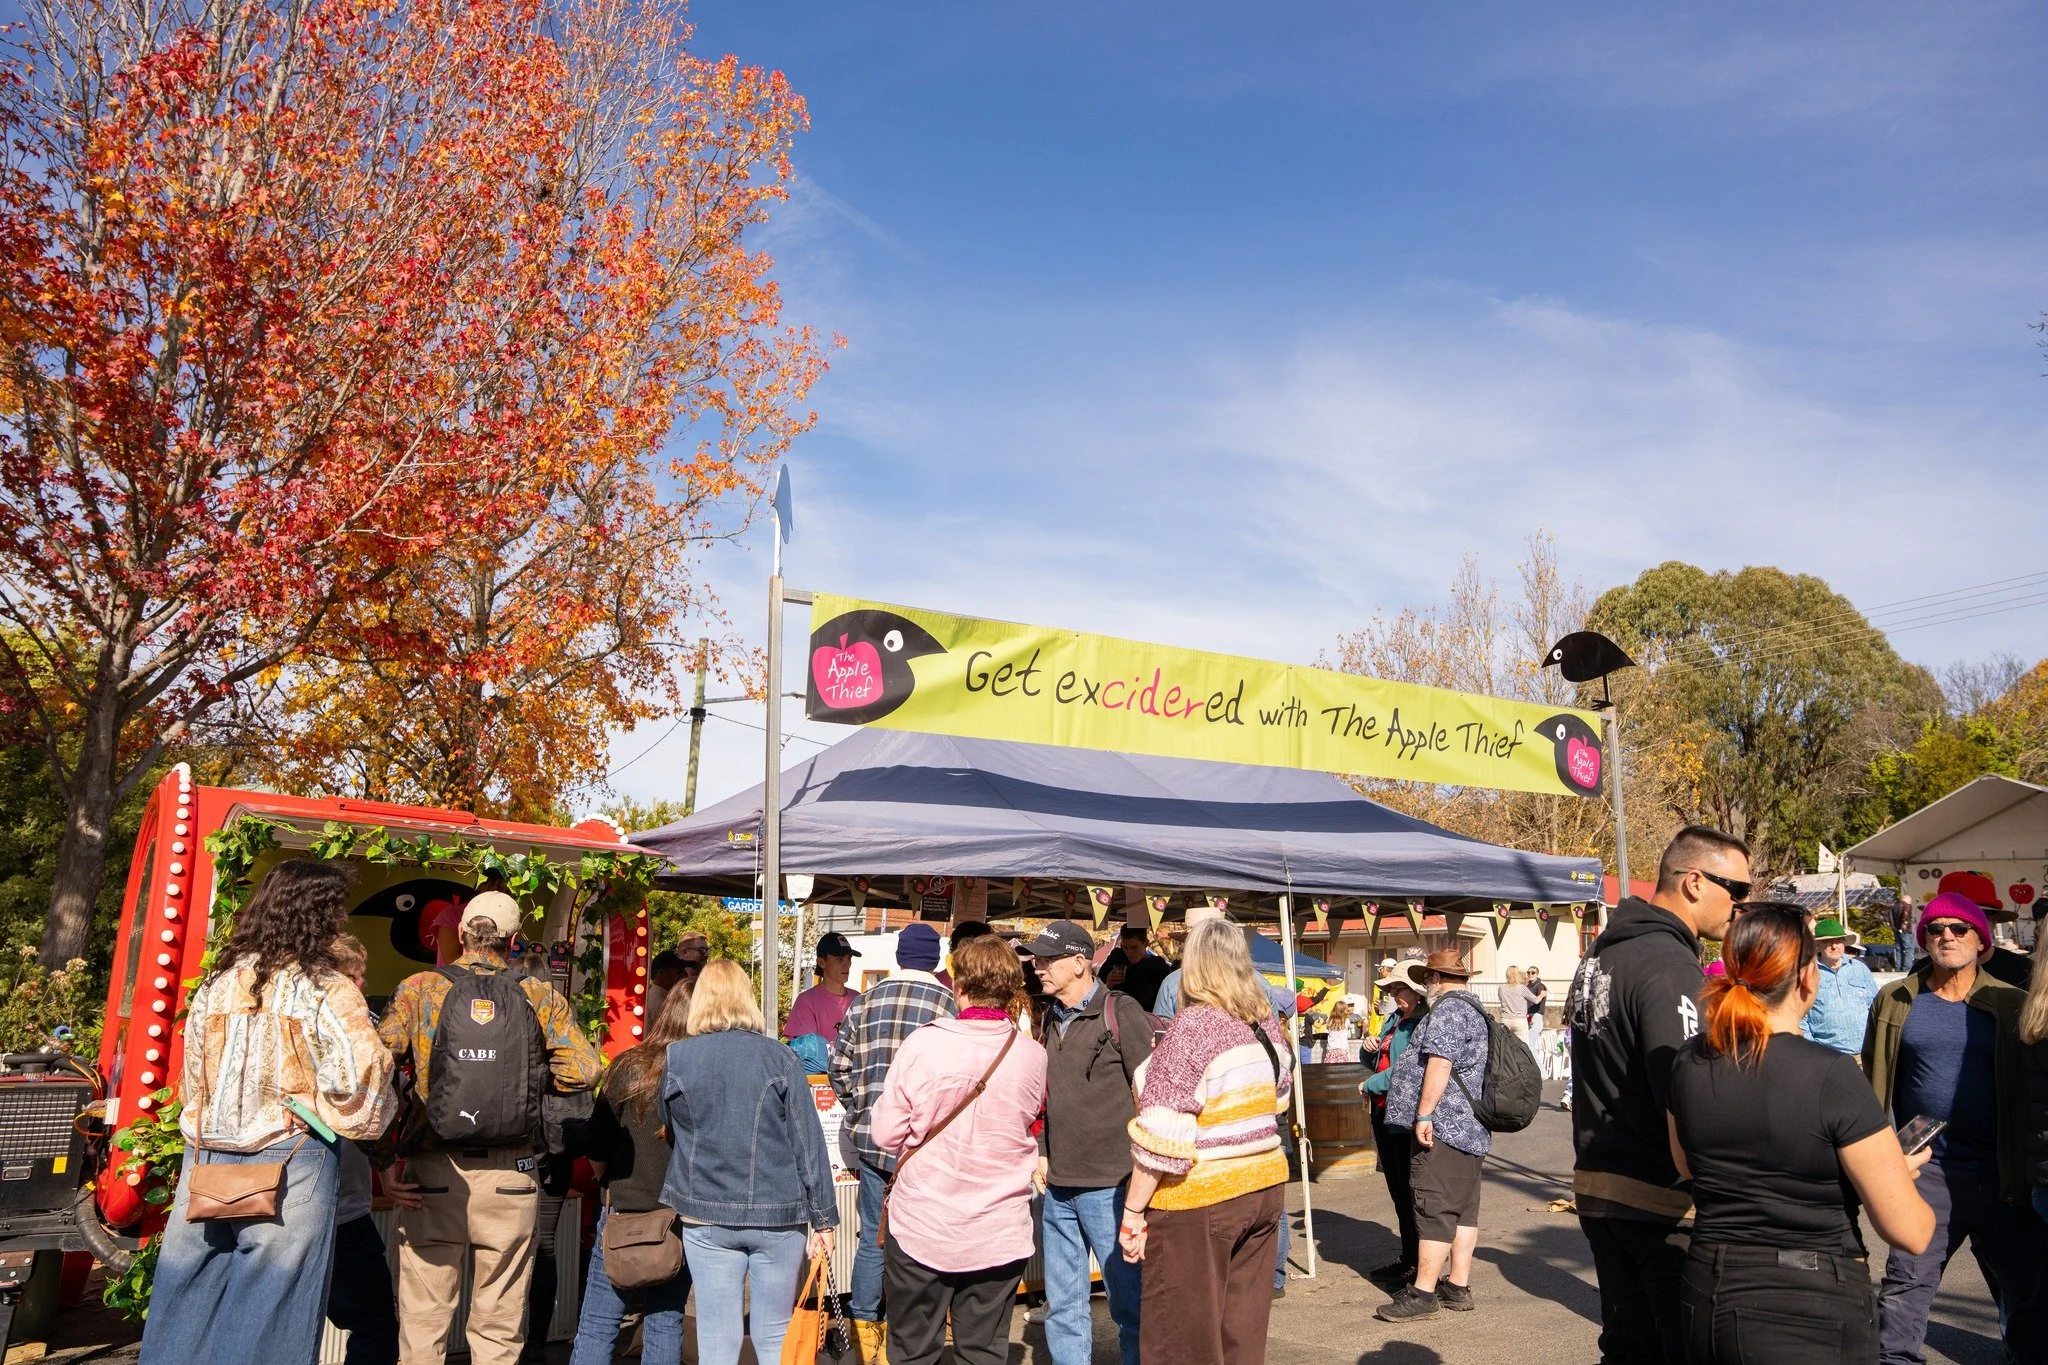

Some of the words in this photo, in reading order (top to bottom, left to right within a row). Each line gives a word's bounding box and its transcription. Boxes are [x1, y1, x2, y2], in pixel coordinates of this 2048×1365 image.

[836, 651, 855, 662] The
[828, 658, 870, 684] Apple
[825, 675, 873, 701] Thief
[966, 648, 1041, 697] Get
[1056, 667, 1245, 726] excidered
[1259, 696, 1308, 728] with
[1321, 703, 1379, 740] The
[1385, 707, 1450, 761] Apple
[1456, 719, 1525, 759] Thief
[1573, 750, 1595, 770] Apple
[1578, 749, 1589, 759] The
[1571, 766, 1595, 783] Thief
[458, 1048, 497, 1059] CABE
